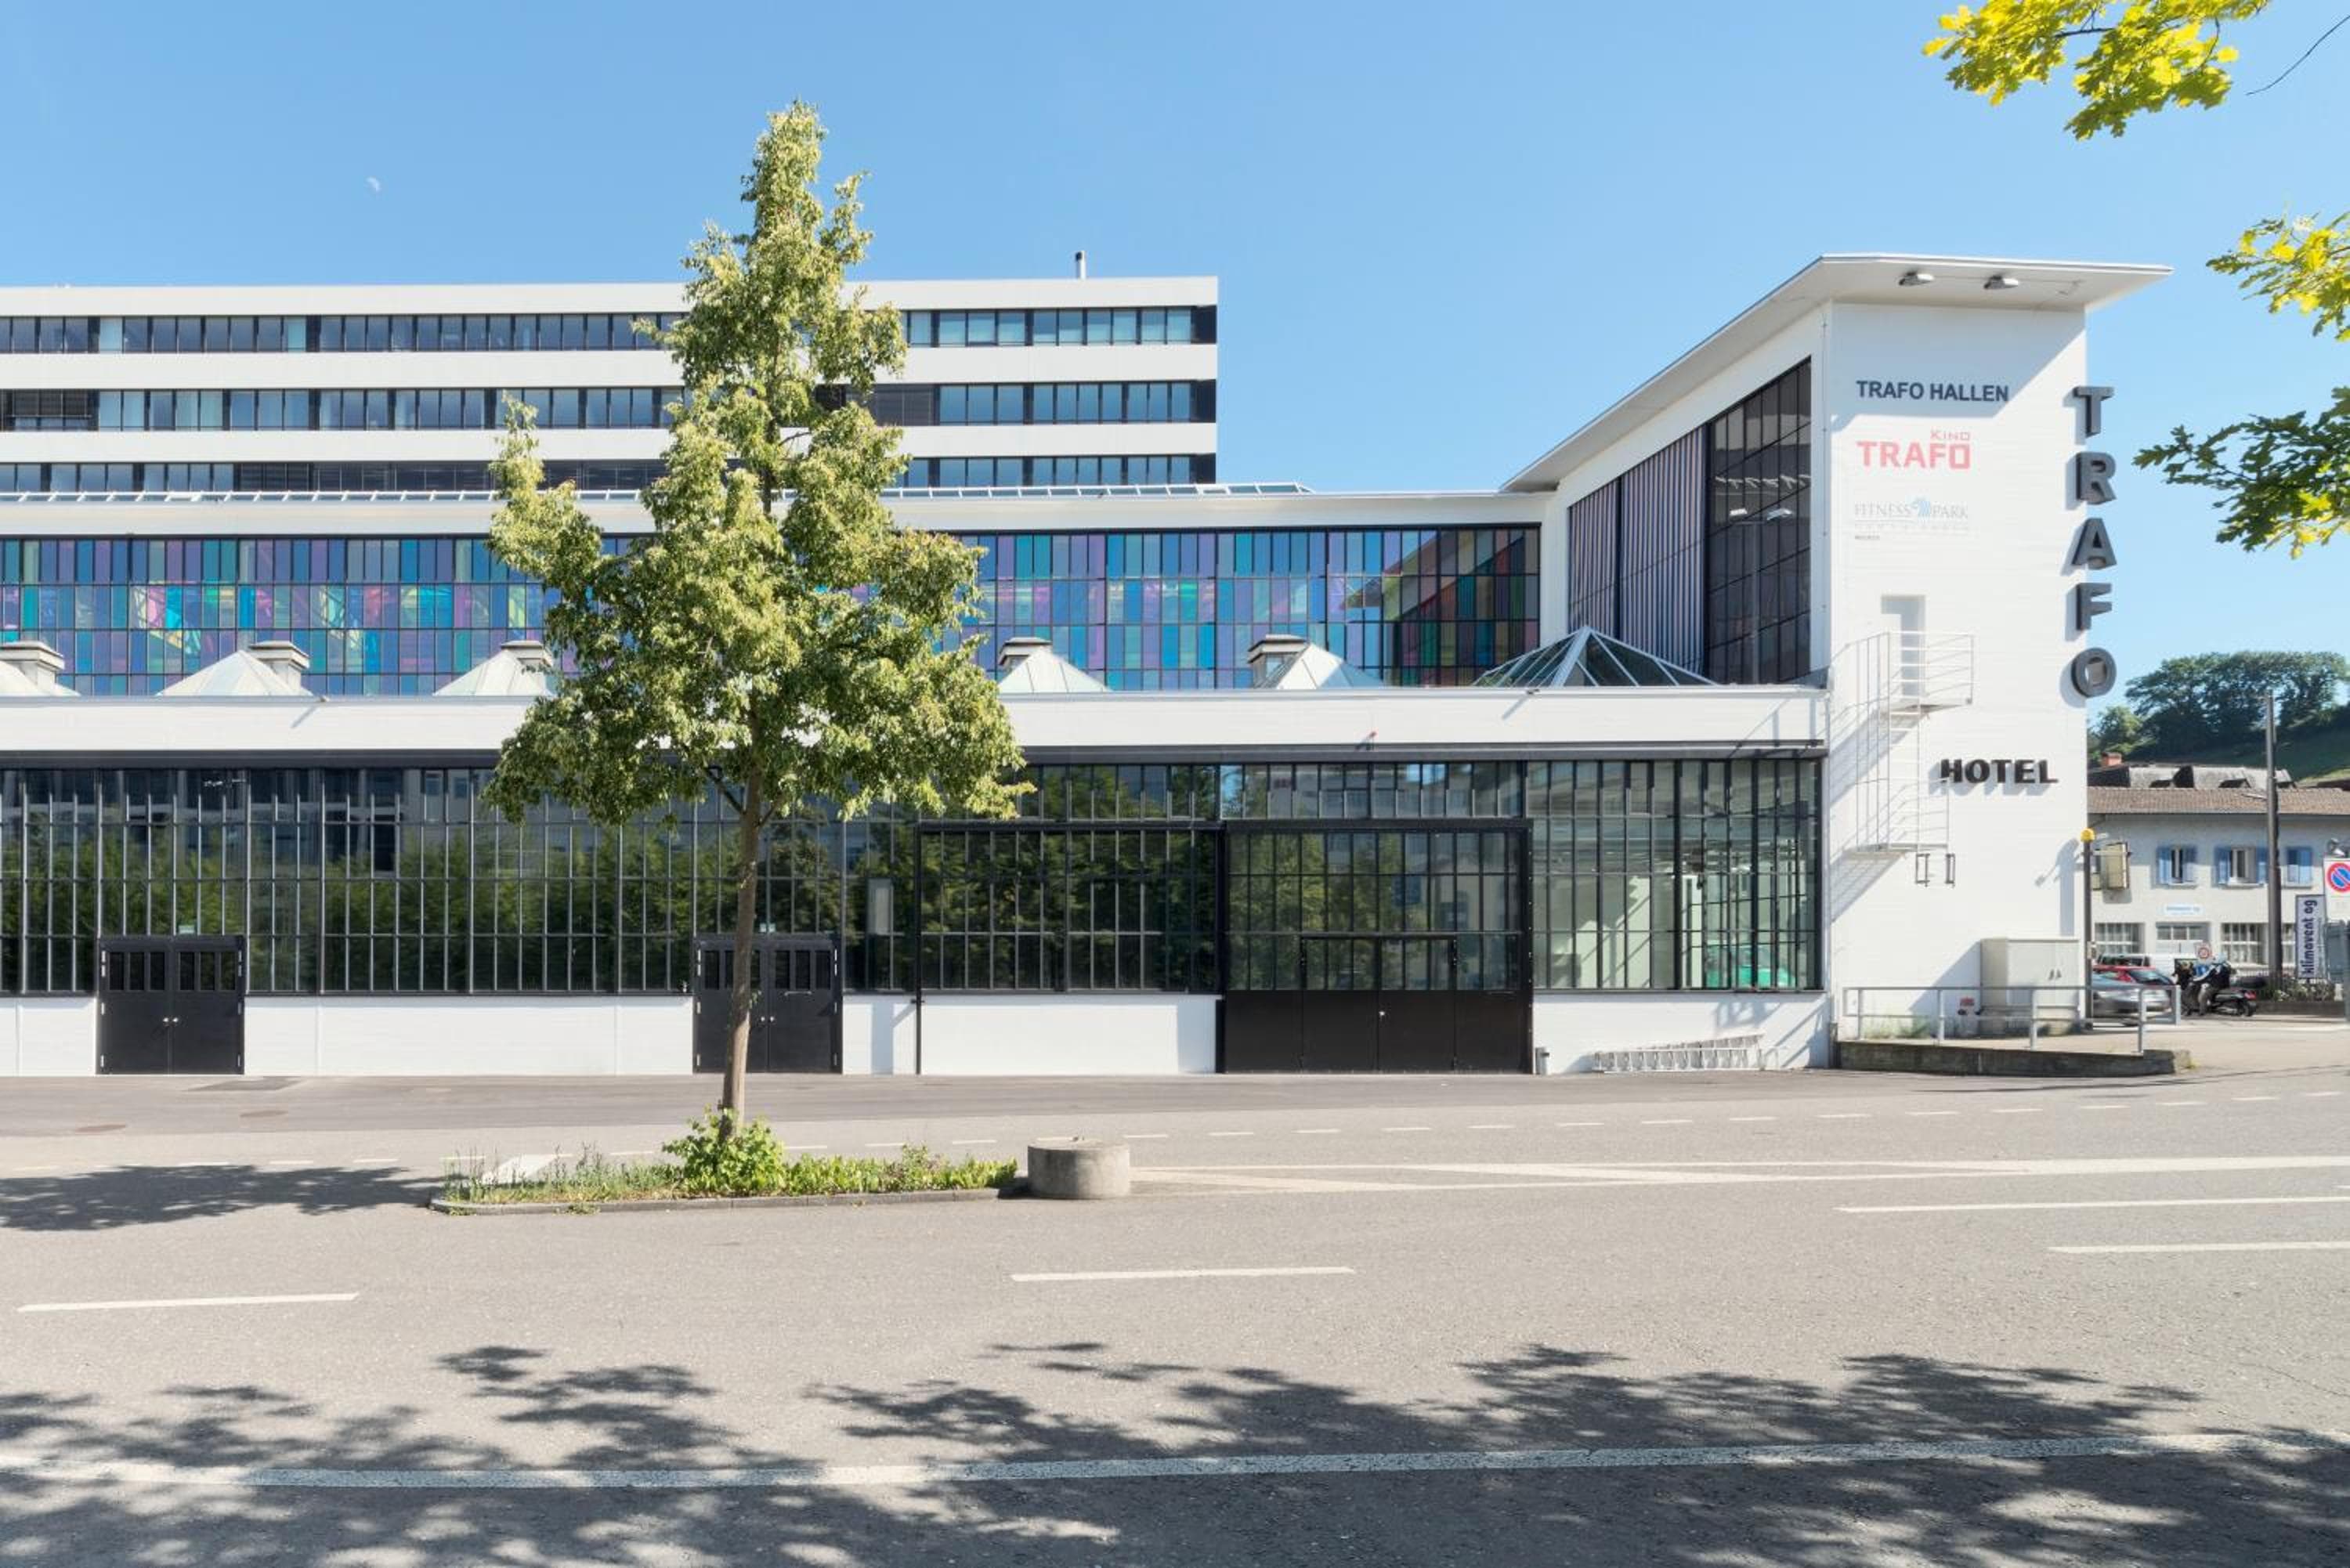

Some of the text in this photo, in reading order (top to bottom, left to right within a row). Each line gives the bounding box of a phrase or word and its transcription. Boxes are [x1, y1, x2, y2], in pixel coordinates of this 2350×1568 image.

[1856, 380, 2009, 402] TRAFO HALLEN
[1856, 441, 1970, 469] TRAFO
[2070, 385, 2117, 699] TRAFO
[1940, 759, 2059, 784] HOTEL
